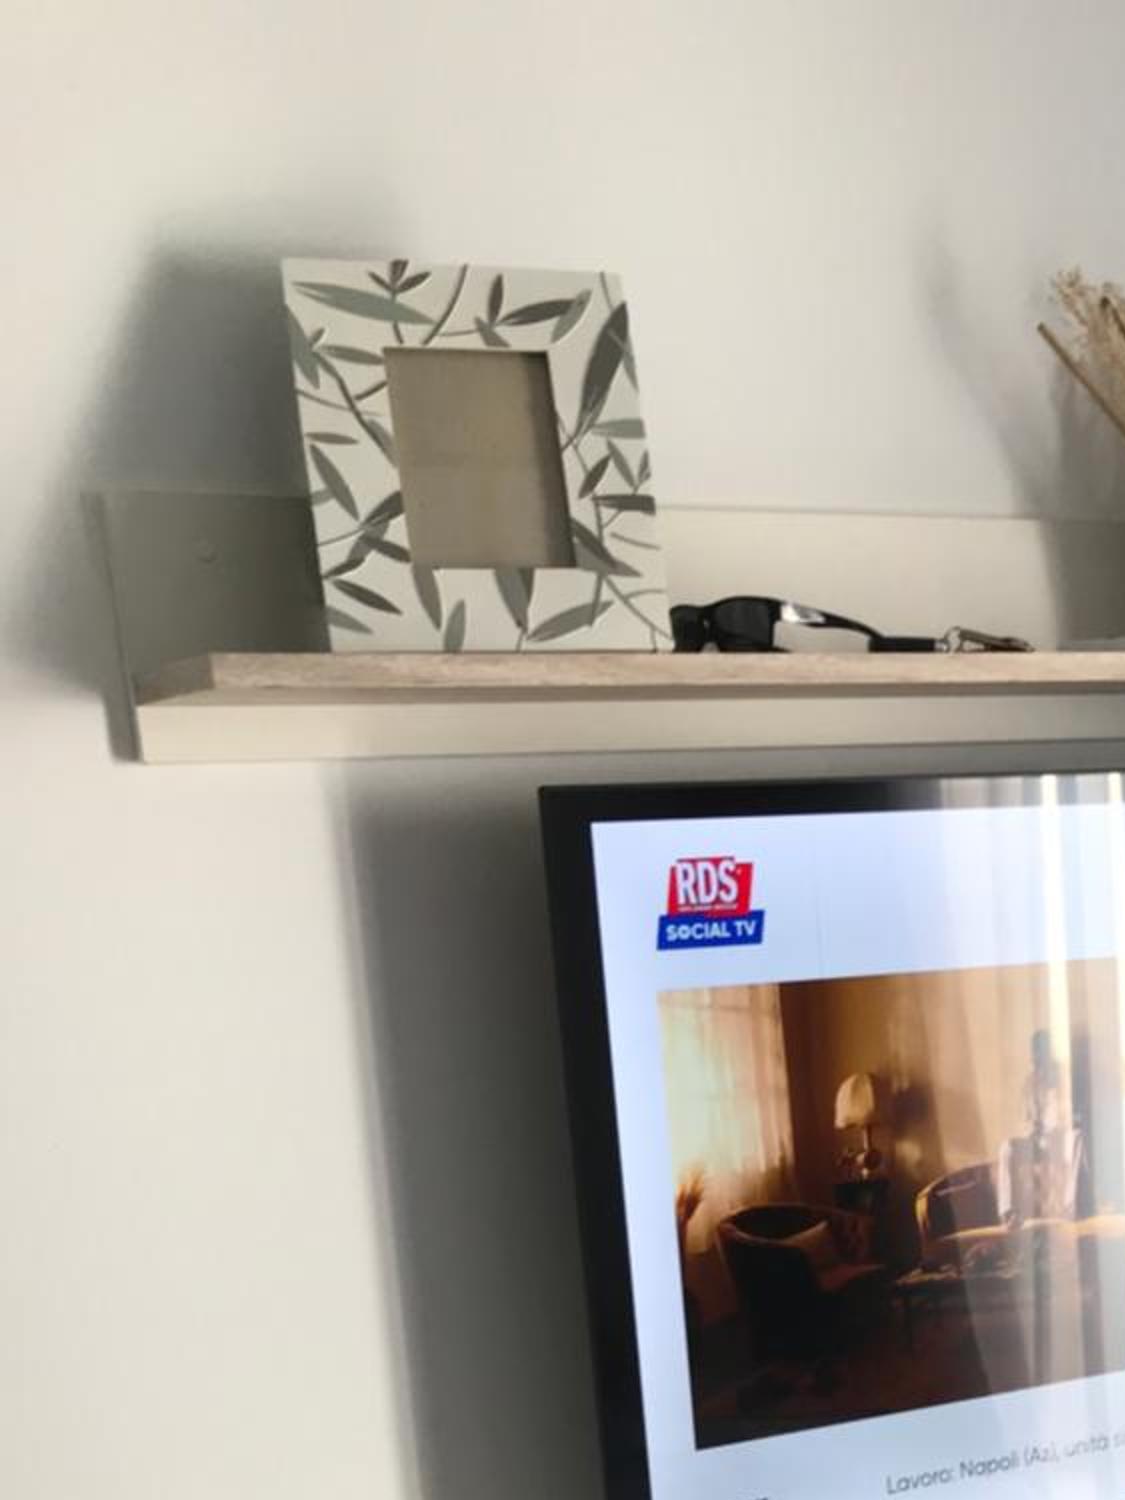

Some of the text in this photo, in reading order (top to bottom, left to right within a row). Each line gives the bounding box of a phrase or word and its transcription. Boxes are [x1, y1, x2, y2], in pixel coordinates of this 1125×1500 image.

[676, 859, 739, 904] RDS
[666, 919, 757, 942] SOCIAL TV
[886, 1465, 955, 1494] Lavoro:
[959, 1448, 1019, 1478] Napoli
